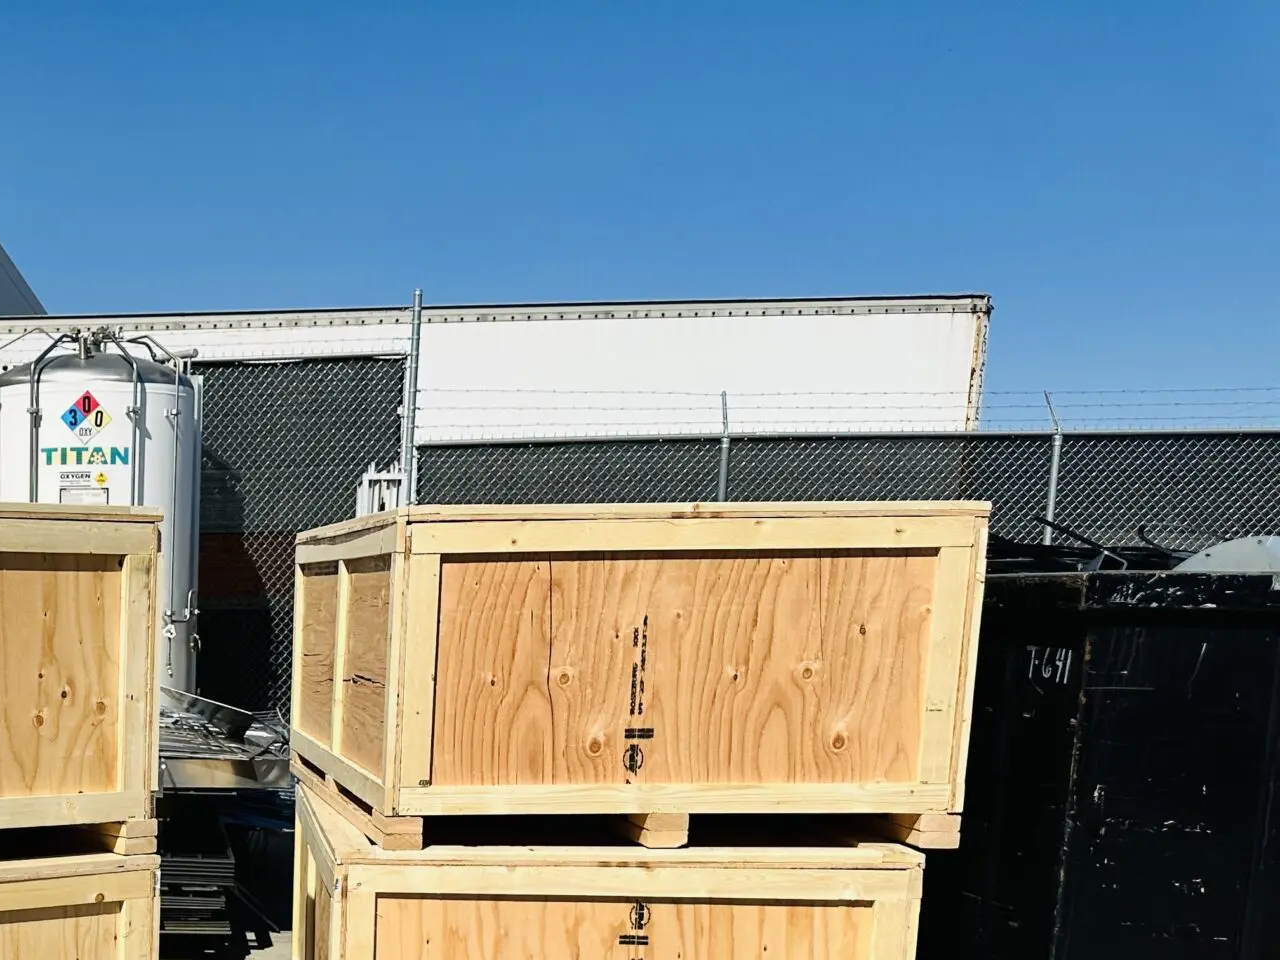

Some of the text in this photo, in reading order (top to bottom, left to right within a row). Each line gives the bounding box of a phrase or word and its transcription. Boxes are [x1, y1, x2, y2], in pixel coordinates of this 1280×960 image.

[82, 396, 91, 414] 0
[68, 409, 103, 427] 3 0
[79, 427, 92, 436] OXY
[41, 447, 129, 465] TITAN
